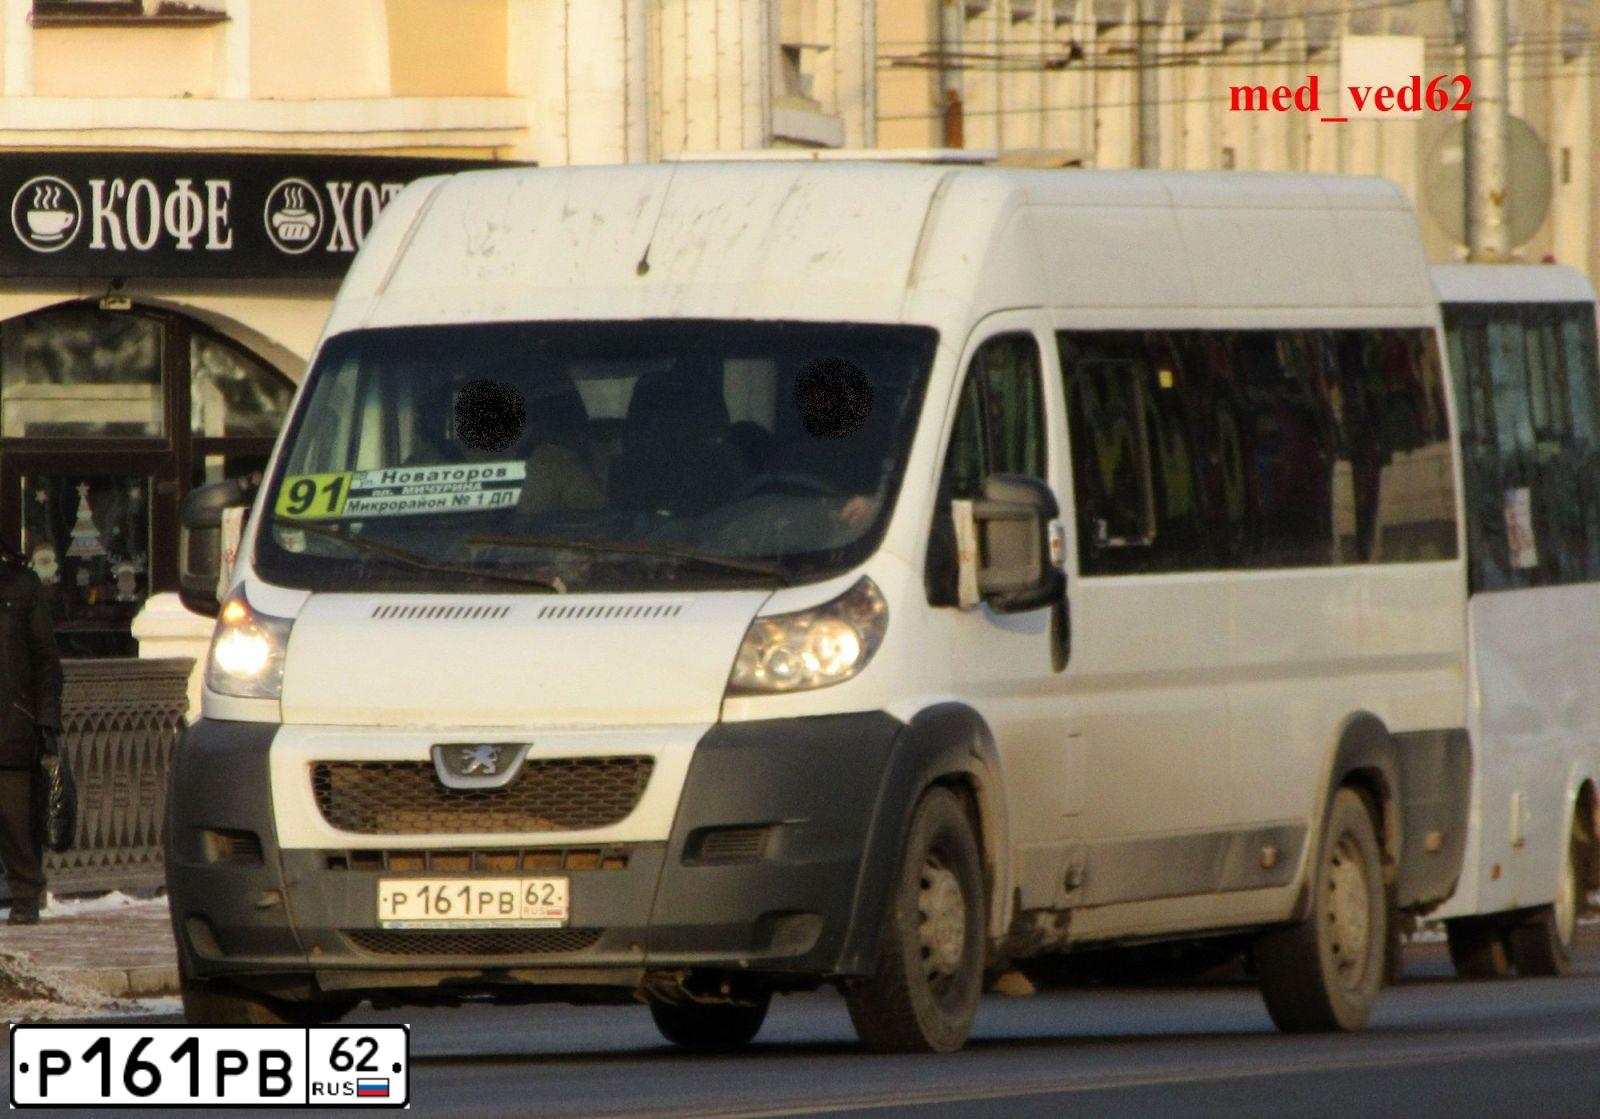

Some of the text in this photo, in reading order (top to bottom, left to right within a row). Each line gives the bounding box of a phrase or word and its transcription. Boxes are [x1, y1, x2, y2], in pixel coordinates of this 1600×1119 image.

[89, 178, 233, 251] КОФЕ
[380, 467, 508, 484] Новаторов
[286, 475, 345, 515] 91
[347, 496, 447, 513] Микрорайон
[452, 494, 472, 507] №
[477, 493, 485, 505] 1
[524, 882, 556, 906] 62
